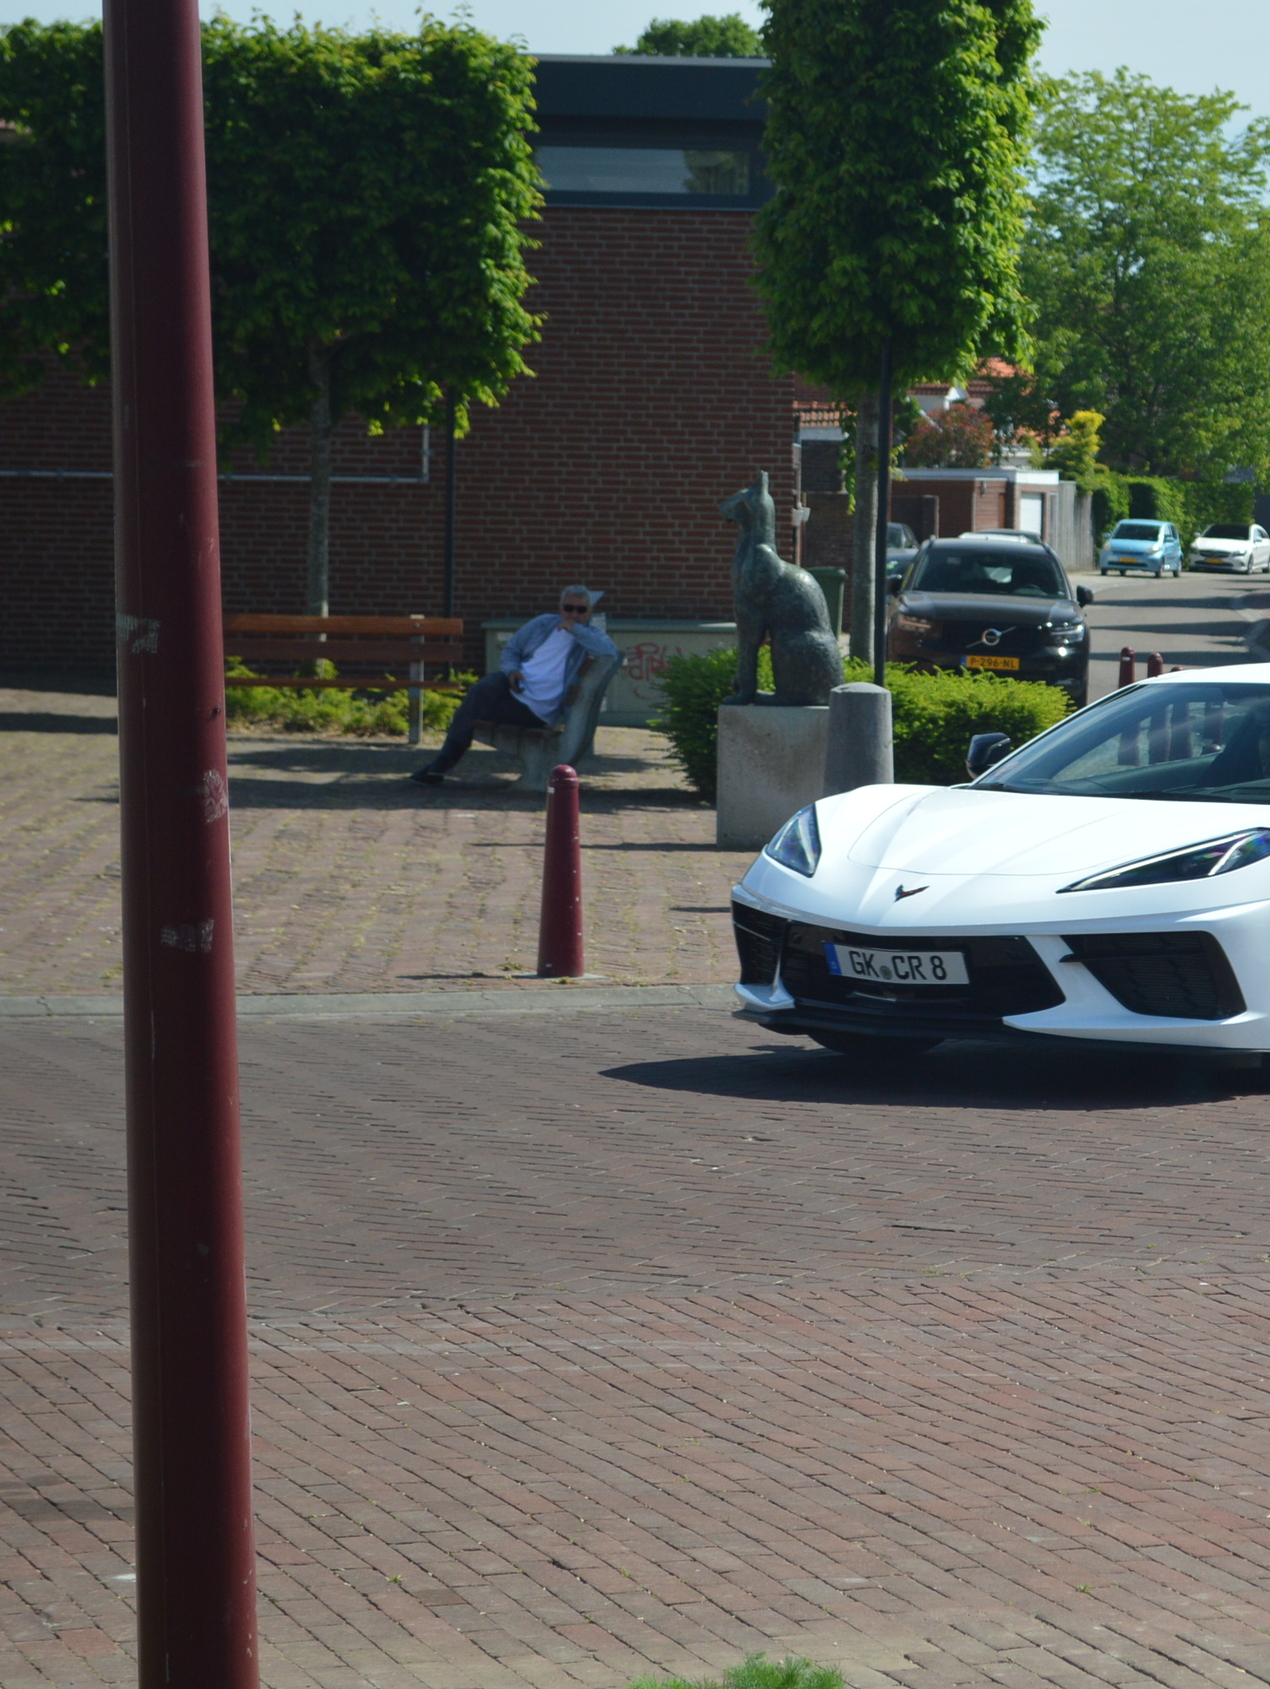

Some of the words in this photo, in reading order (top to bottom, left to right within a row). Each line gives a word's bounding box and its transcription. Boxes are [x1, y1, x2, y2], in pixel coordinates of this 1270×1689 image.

[849, 950, 880, 978] GK
[891, 955, 927, 980] CR
[930, 955, 947, 981] 8
